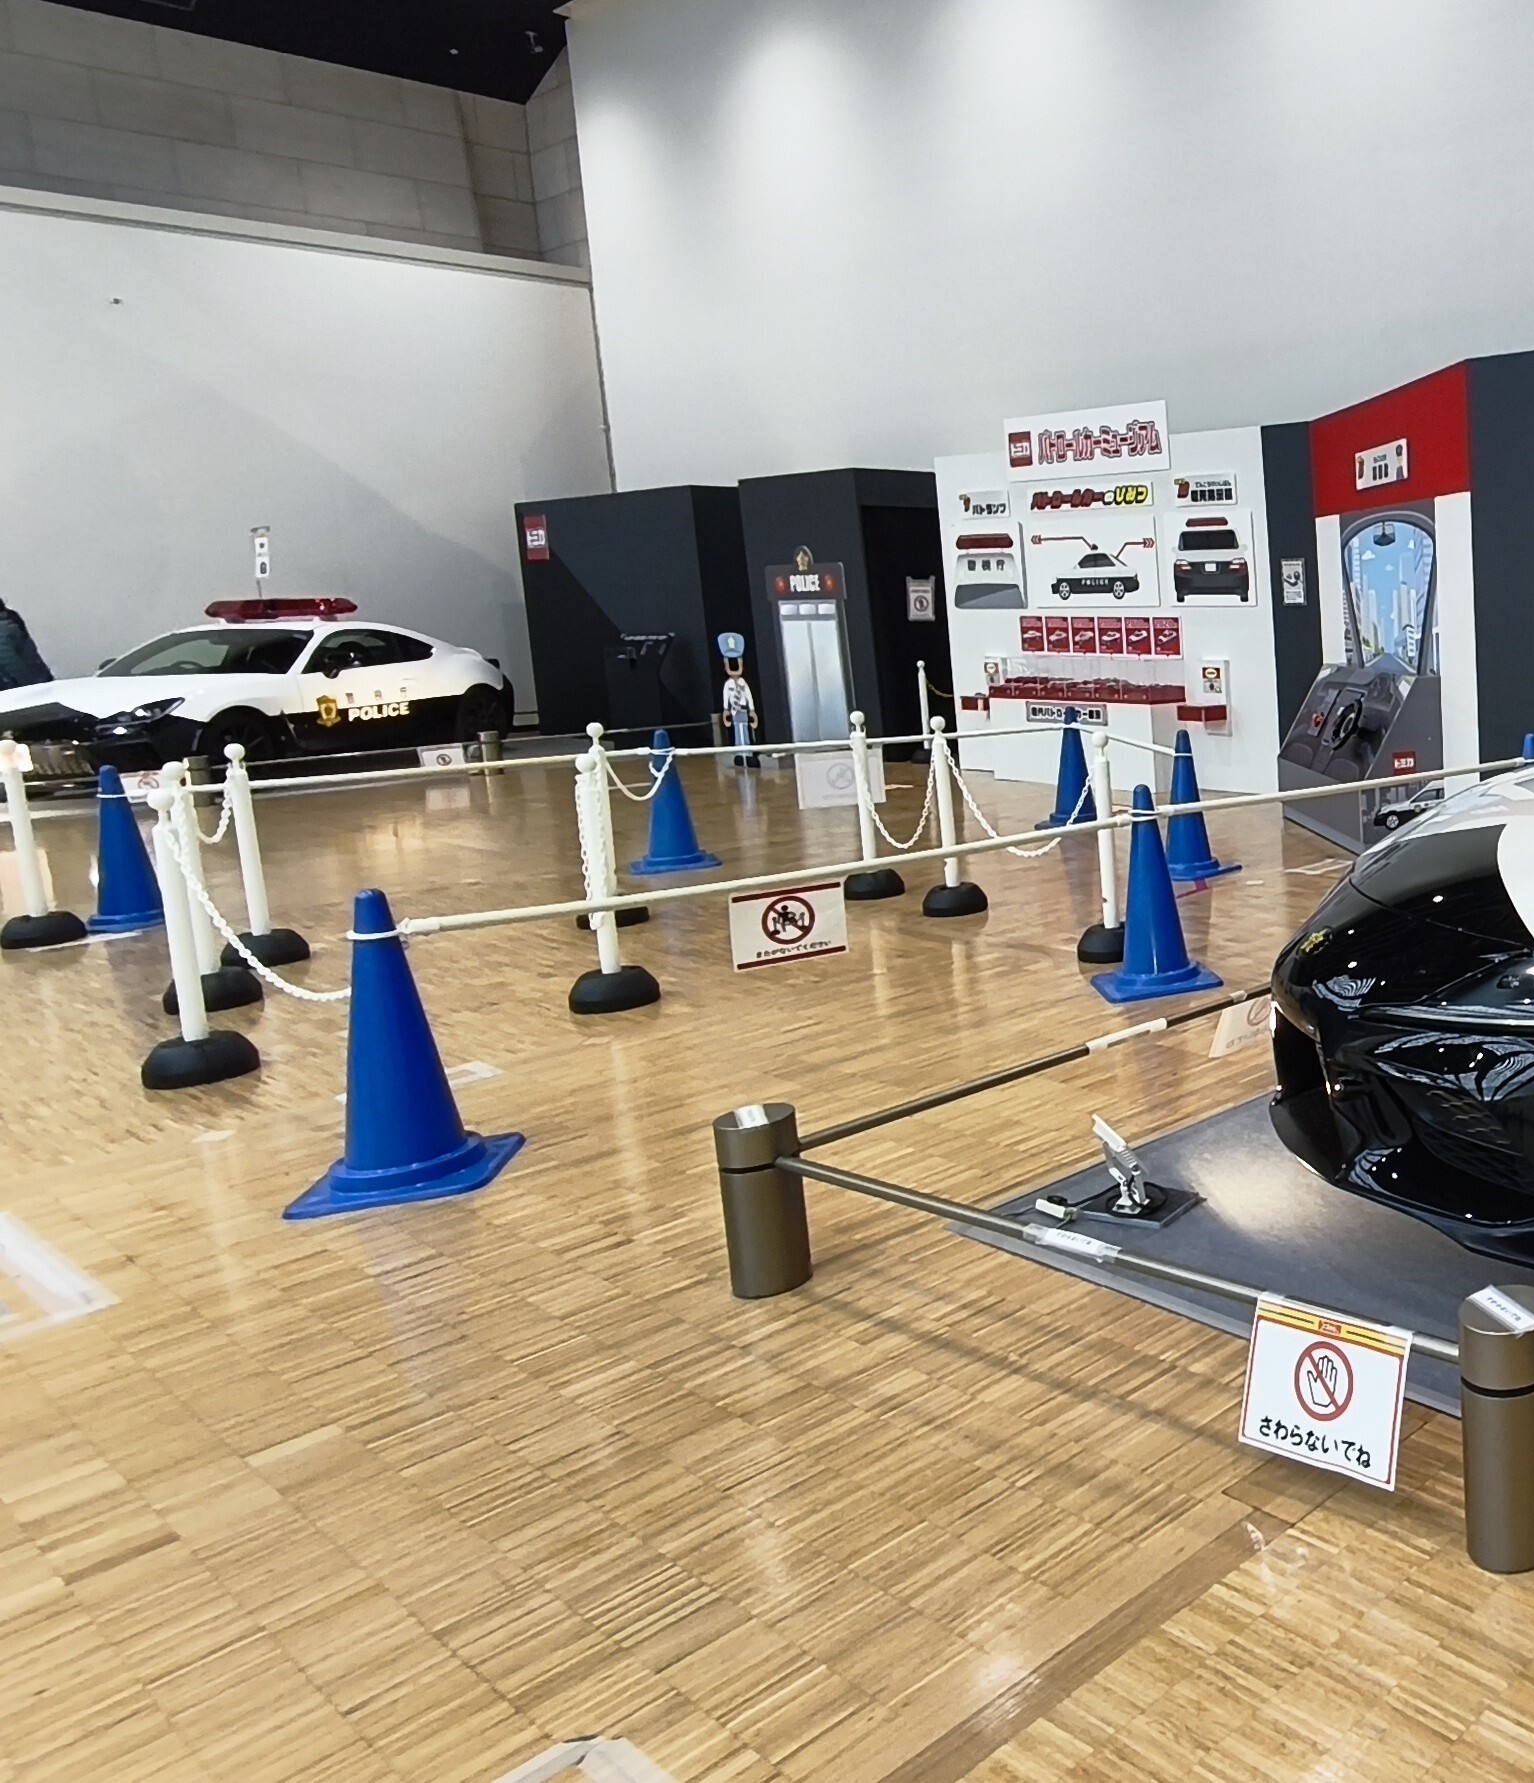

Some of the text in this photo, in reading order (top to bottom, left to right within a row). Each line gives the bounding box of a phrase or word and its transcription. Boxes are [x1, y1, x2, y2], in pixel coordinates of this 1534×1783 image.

[1038, 419, 1162, 465] パトロールカーミュージアム
[789, 574, 820, 592] POLICE
[348, 701, 410, 722] POLICE
[1259, 1416, 1371, 1468] さわらないでね
